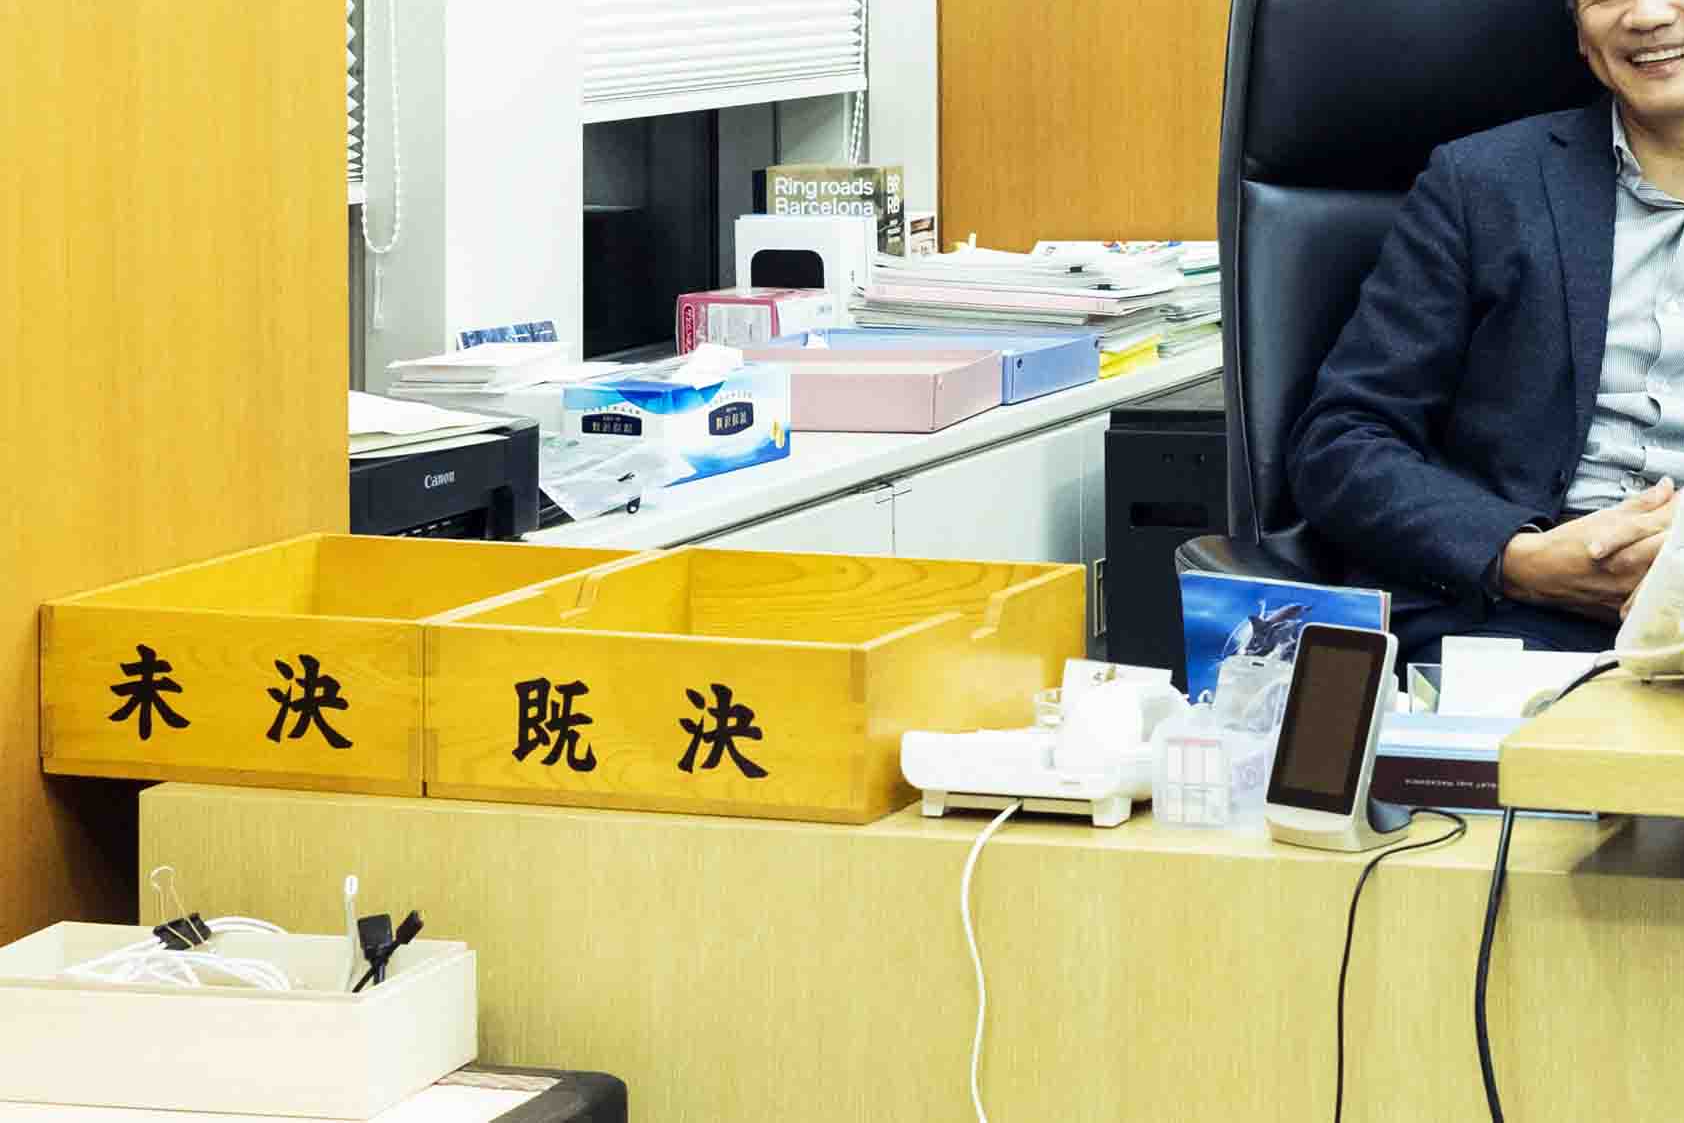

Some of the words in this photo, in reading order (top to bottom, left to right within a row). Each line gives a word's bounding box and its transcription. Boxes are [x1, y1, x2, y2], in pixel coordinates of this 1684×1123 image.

[775, 176, 818, 199] Ring
[820, 178, 874, 196] roads
[775, 198, 875, 215] Barcelona
[424, 470, 455, 489] Canon
[108, 644, 353, 750] 未決
[511, 677, 768, 779] 既決
